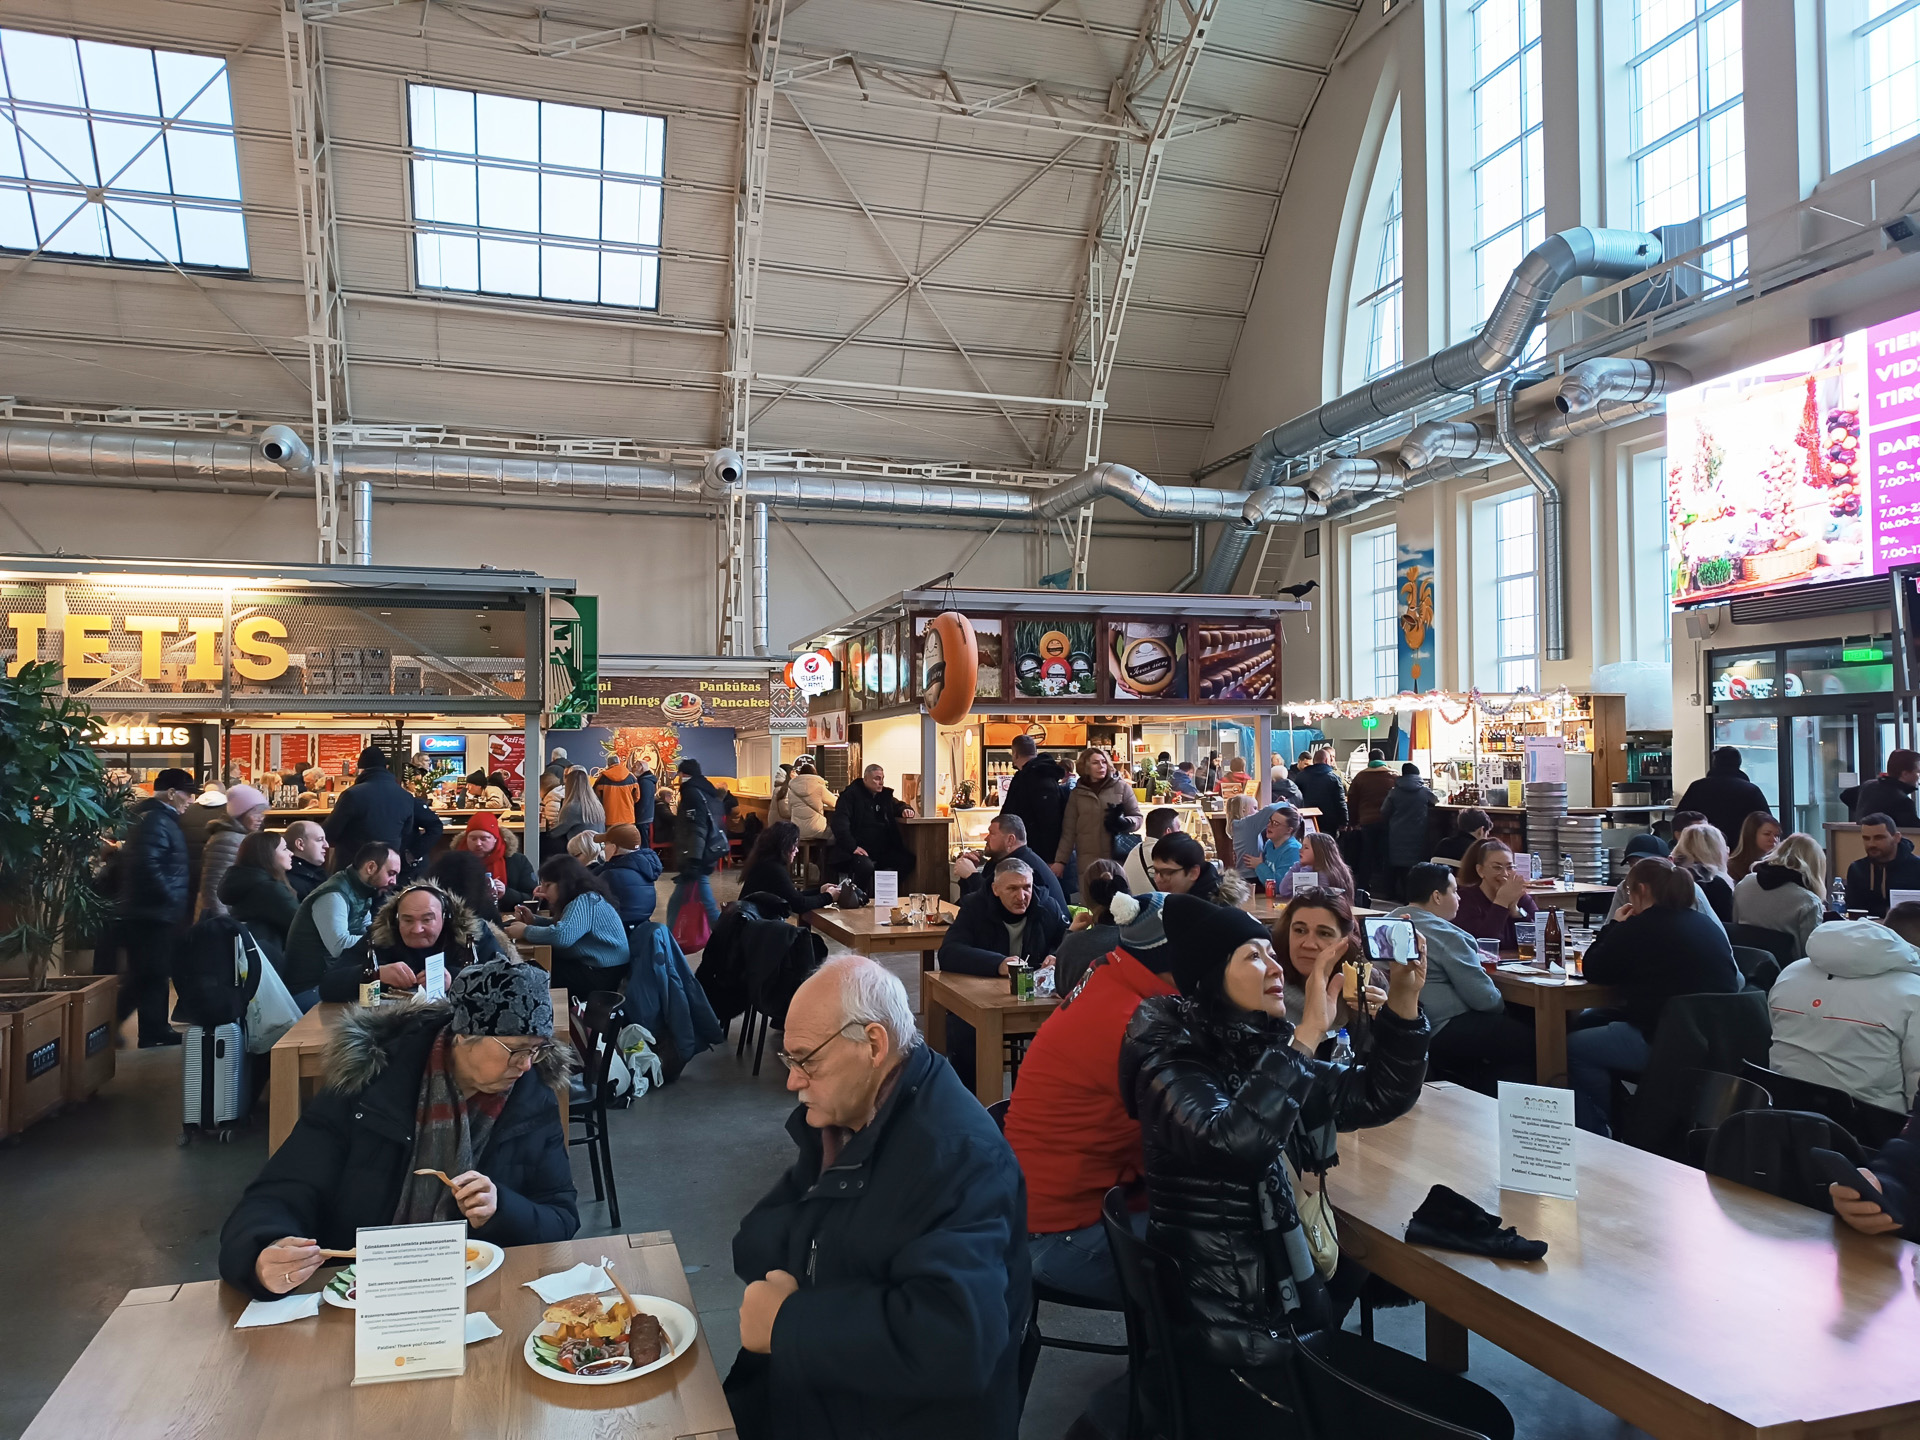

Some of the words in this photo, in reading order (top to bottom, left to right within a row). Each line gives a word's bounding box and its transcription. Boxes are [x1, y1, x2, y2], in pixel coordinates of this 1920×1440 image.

[1875, 356, 1920, 382] VID
[7, 612, 290, 680] IETIS
[700, 682, 761, 692] Pankūkas
[712, 697, 770, 708] Pancakes
